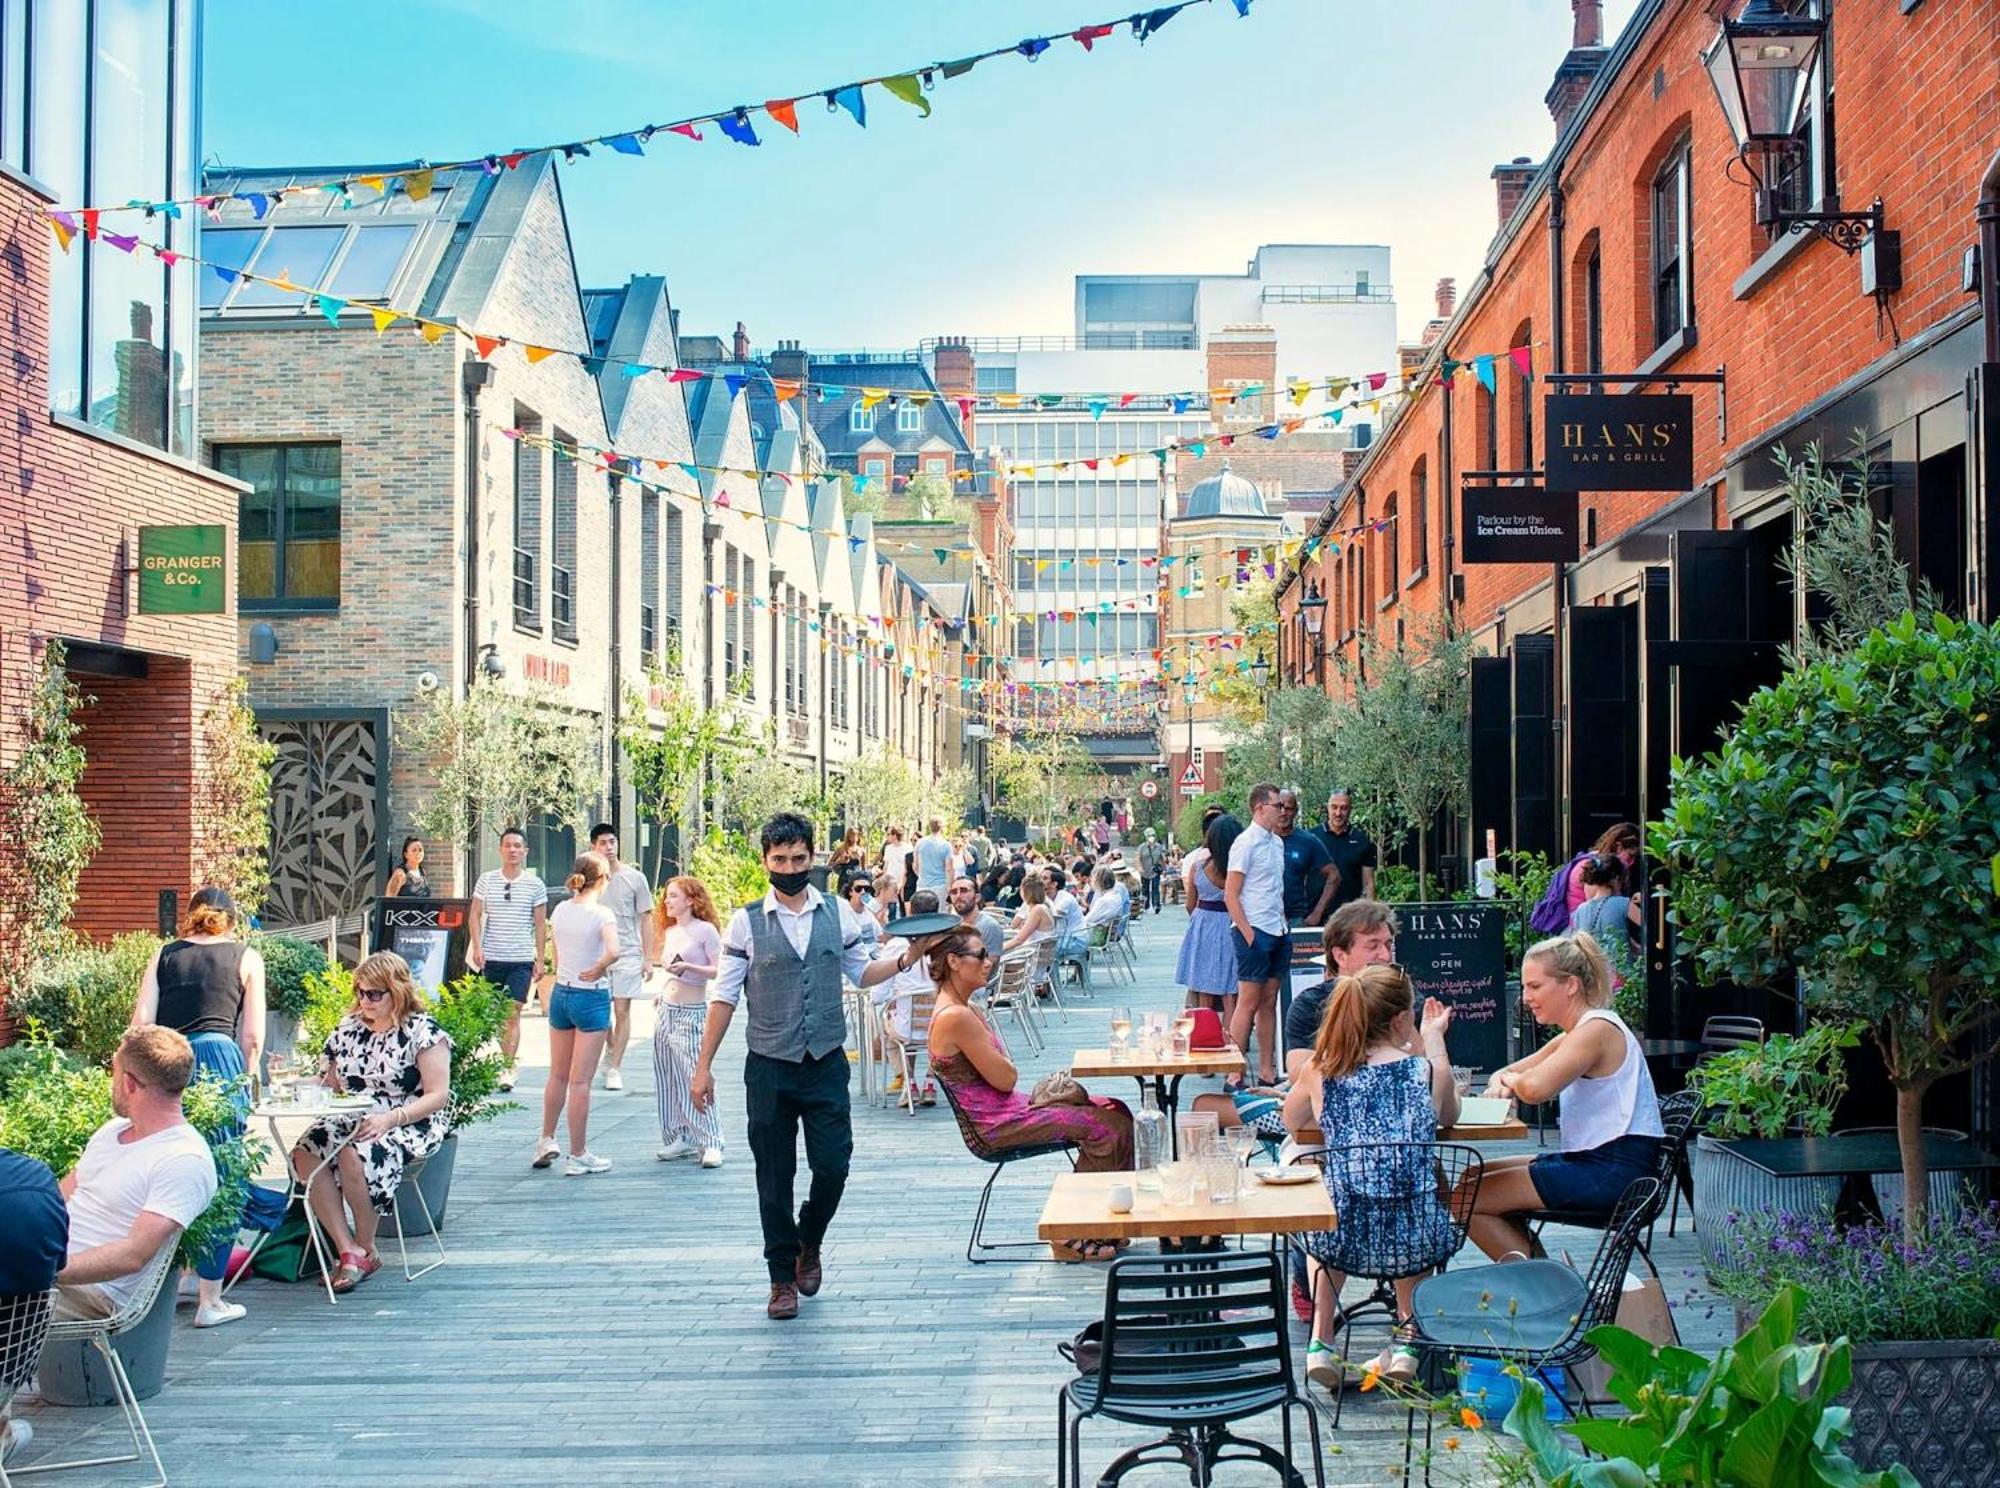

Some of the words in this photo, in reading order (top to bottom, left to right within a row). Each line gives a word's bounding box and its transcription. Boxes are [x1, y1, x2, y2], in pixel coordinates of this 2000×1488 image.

[1572, 453, 1599, 462] BAR
[1608, 453, 1616, 462] &
[1624, 453, 1666, 462] GRILL
[1477, 515, 1512, 525] Parlour
[1513, 515, 1526, 526] by
[1527, 515, 1544, 525] the
[1477, 526, 1493, 535] Ice
[1494, 526, 1529, 535] Cream
[1529, 526, 1564, 535] Union.
[144, 556, 222, 569] GRANGER
[164, 572, 175, 585] &
[177, 572, 202, 585] Co.
[385, 910, 464, 927] KXU
[1431, 960, 1462, 968] OPEN
